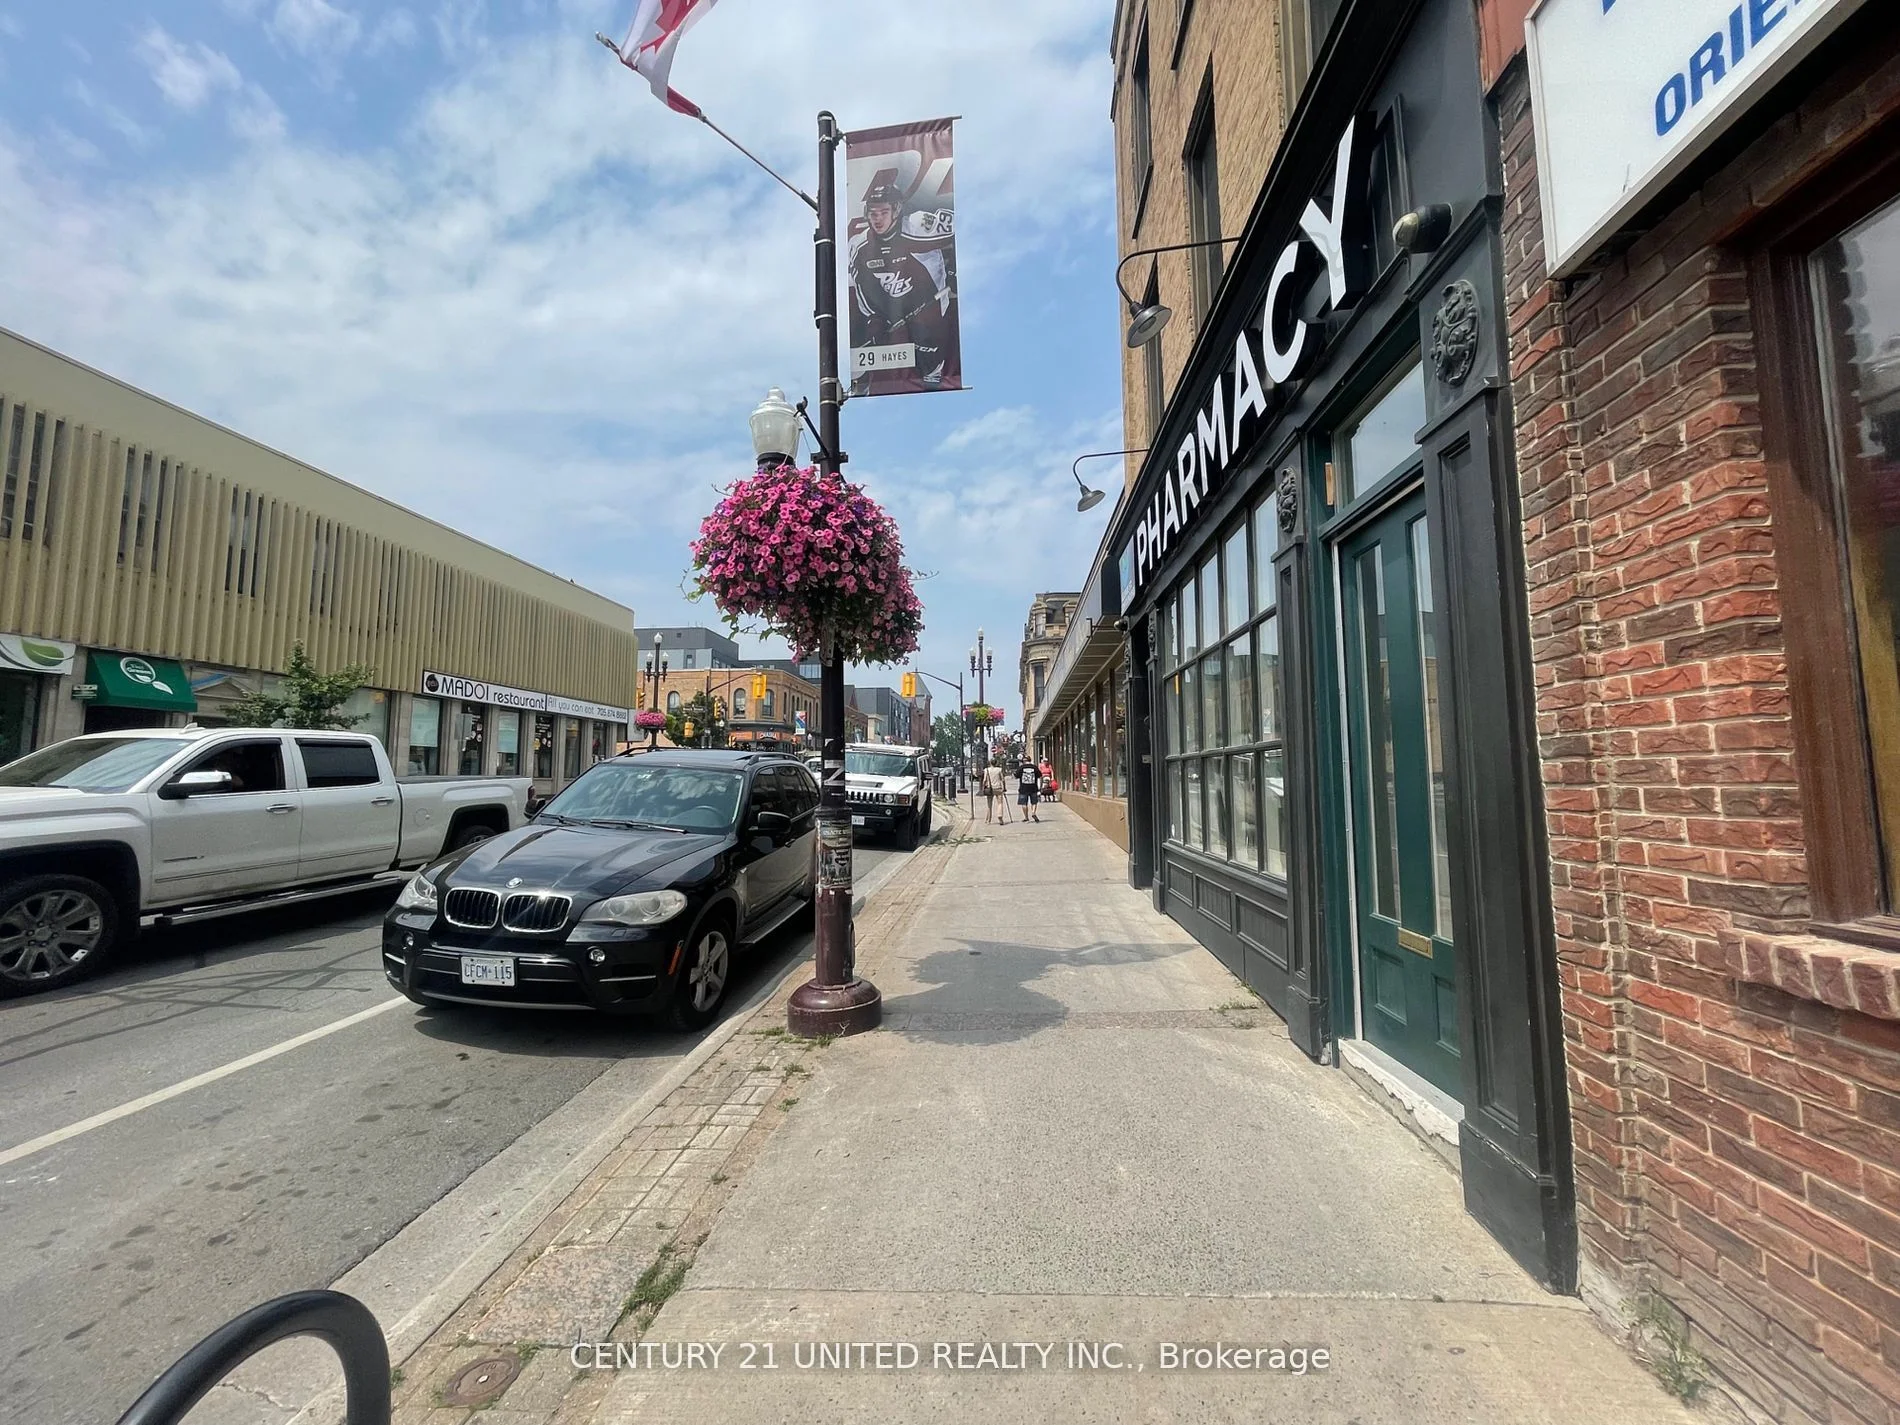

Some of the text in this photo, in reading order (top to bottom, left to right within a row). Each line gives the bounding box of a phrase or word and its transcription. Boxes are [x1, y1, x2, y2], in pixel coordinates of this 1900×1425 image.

[1655, 0, 1808, 136] ORIE
[859, 351, 908, 367] 29 HAYES
[1133, 114, 1356, 588] PHARMACY
[441, 677, 545, 710] MADOI restaurant
[548, 696, 558, 708] All
[558, 701, 570, 712] you
[571, 703, 584, 713] can
